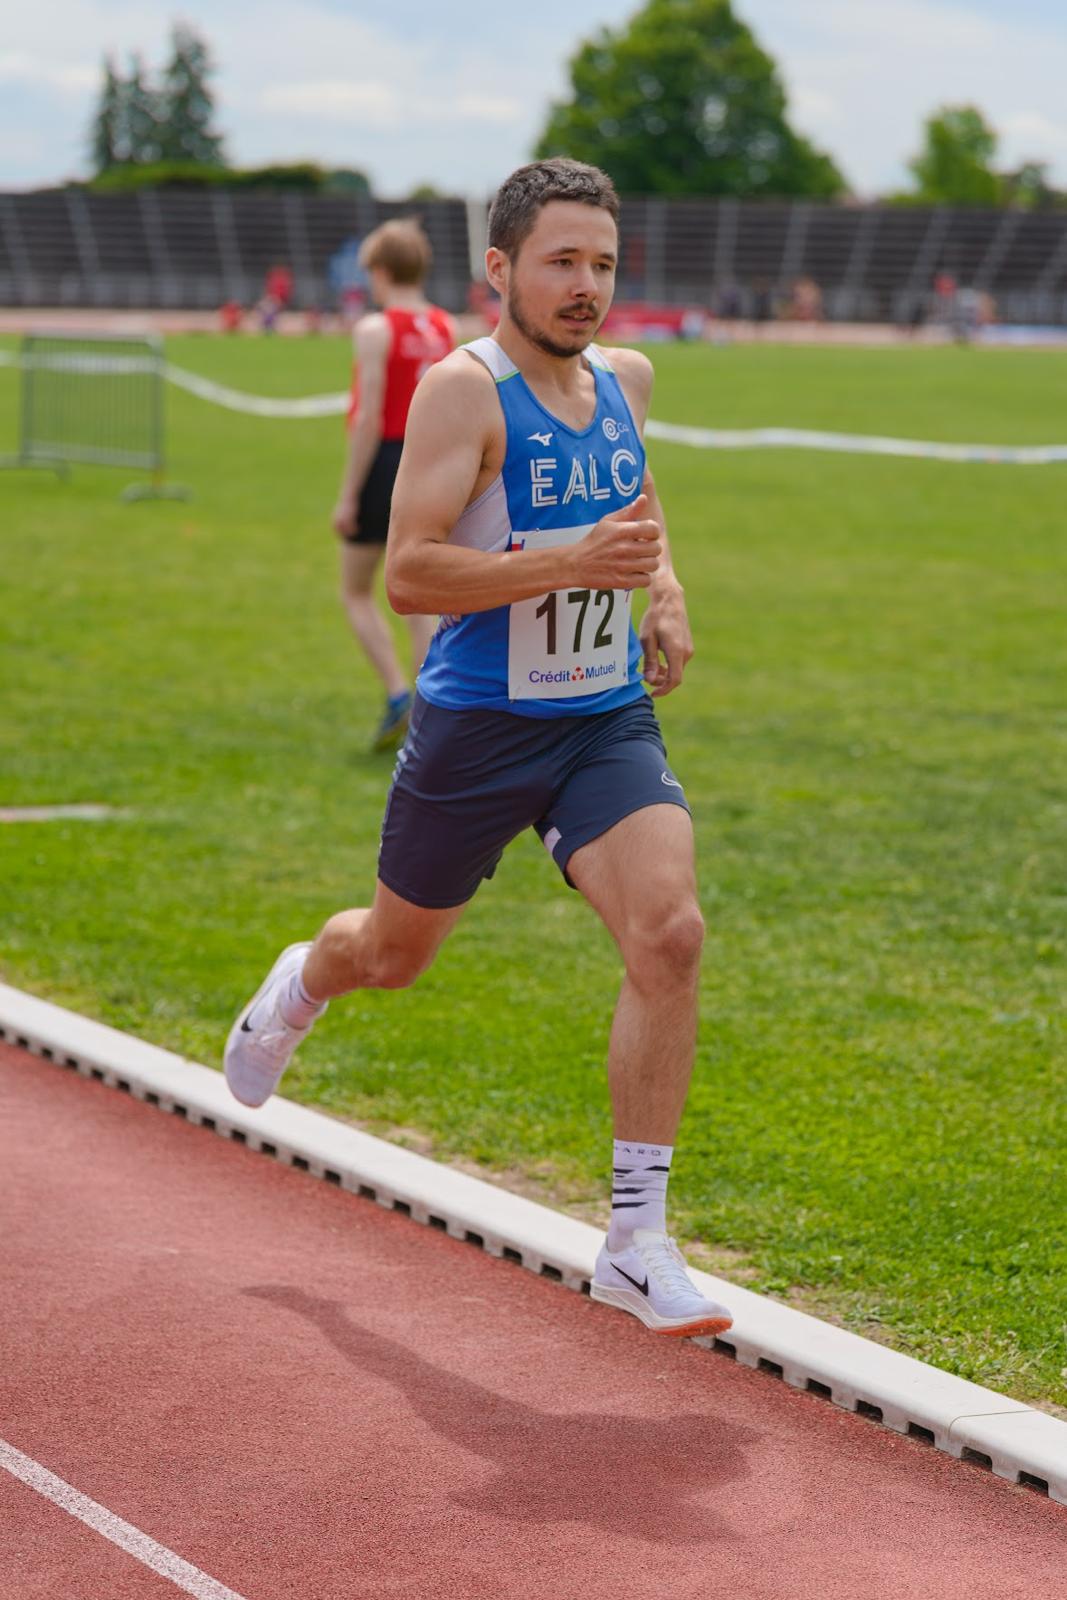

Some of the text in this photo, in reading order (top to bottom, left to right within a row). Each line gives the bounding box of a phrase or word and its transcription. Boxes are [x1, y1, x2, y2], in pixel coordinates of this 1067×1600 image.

[530, 448, 639, 507] EALC
[536, 589, 615, 655] 172
[528, 660, 616, 684] Crédit Mutuel
